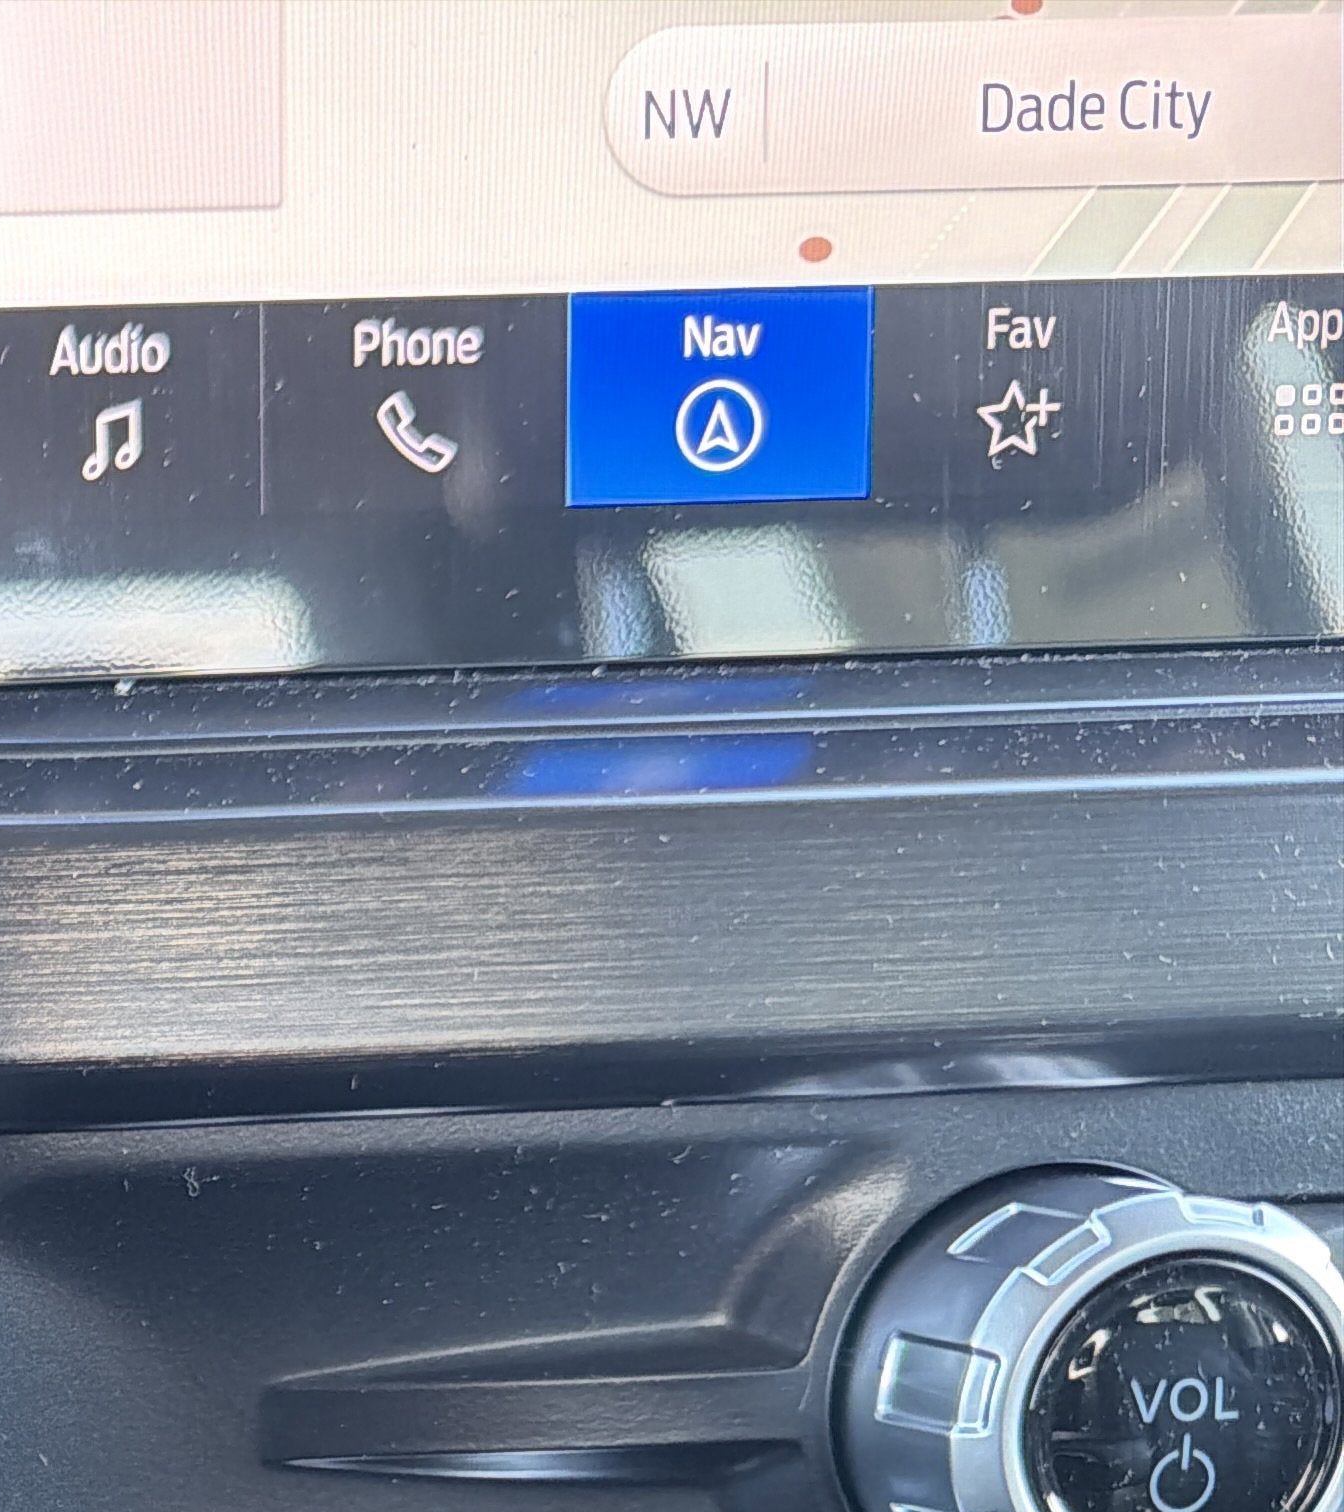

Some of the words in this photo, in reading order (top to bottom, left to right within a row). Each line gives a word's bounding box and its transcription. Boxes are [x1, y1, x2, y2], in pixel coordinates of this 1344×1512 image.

[643, 88, 732, 139] NW
[980, 80, 1105, 132] Dade
[1119, 79, 1212, 139] City
[49, 321, 171, 376] Audio
[352, 317, 486, 368] Phone
[682, 315, 761, 359] Nav
[985, 307, 1057, 350] Fav
[1131, 1376, 1240, 1423] VOL
